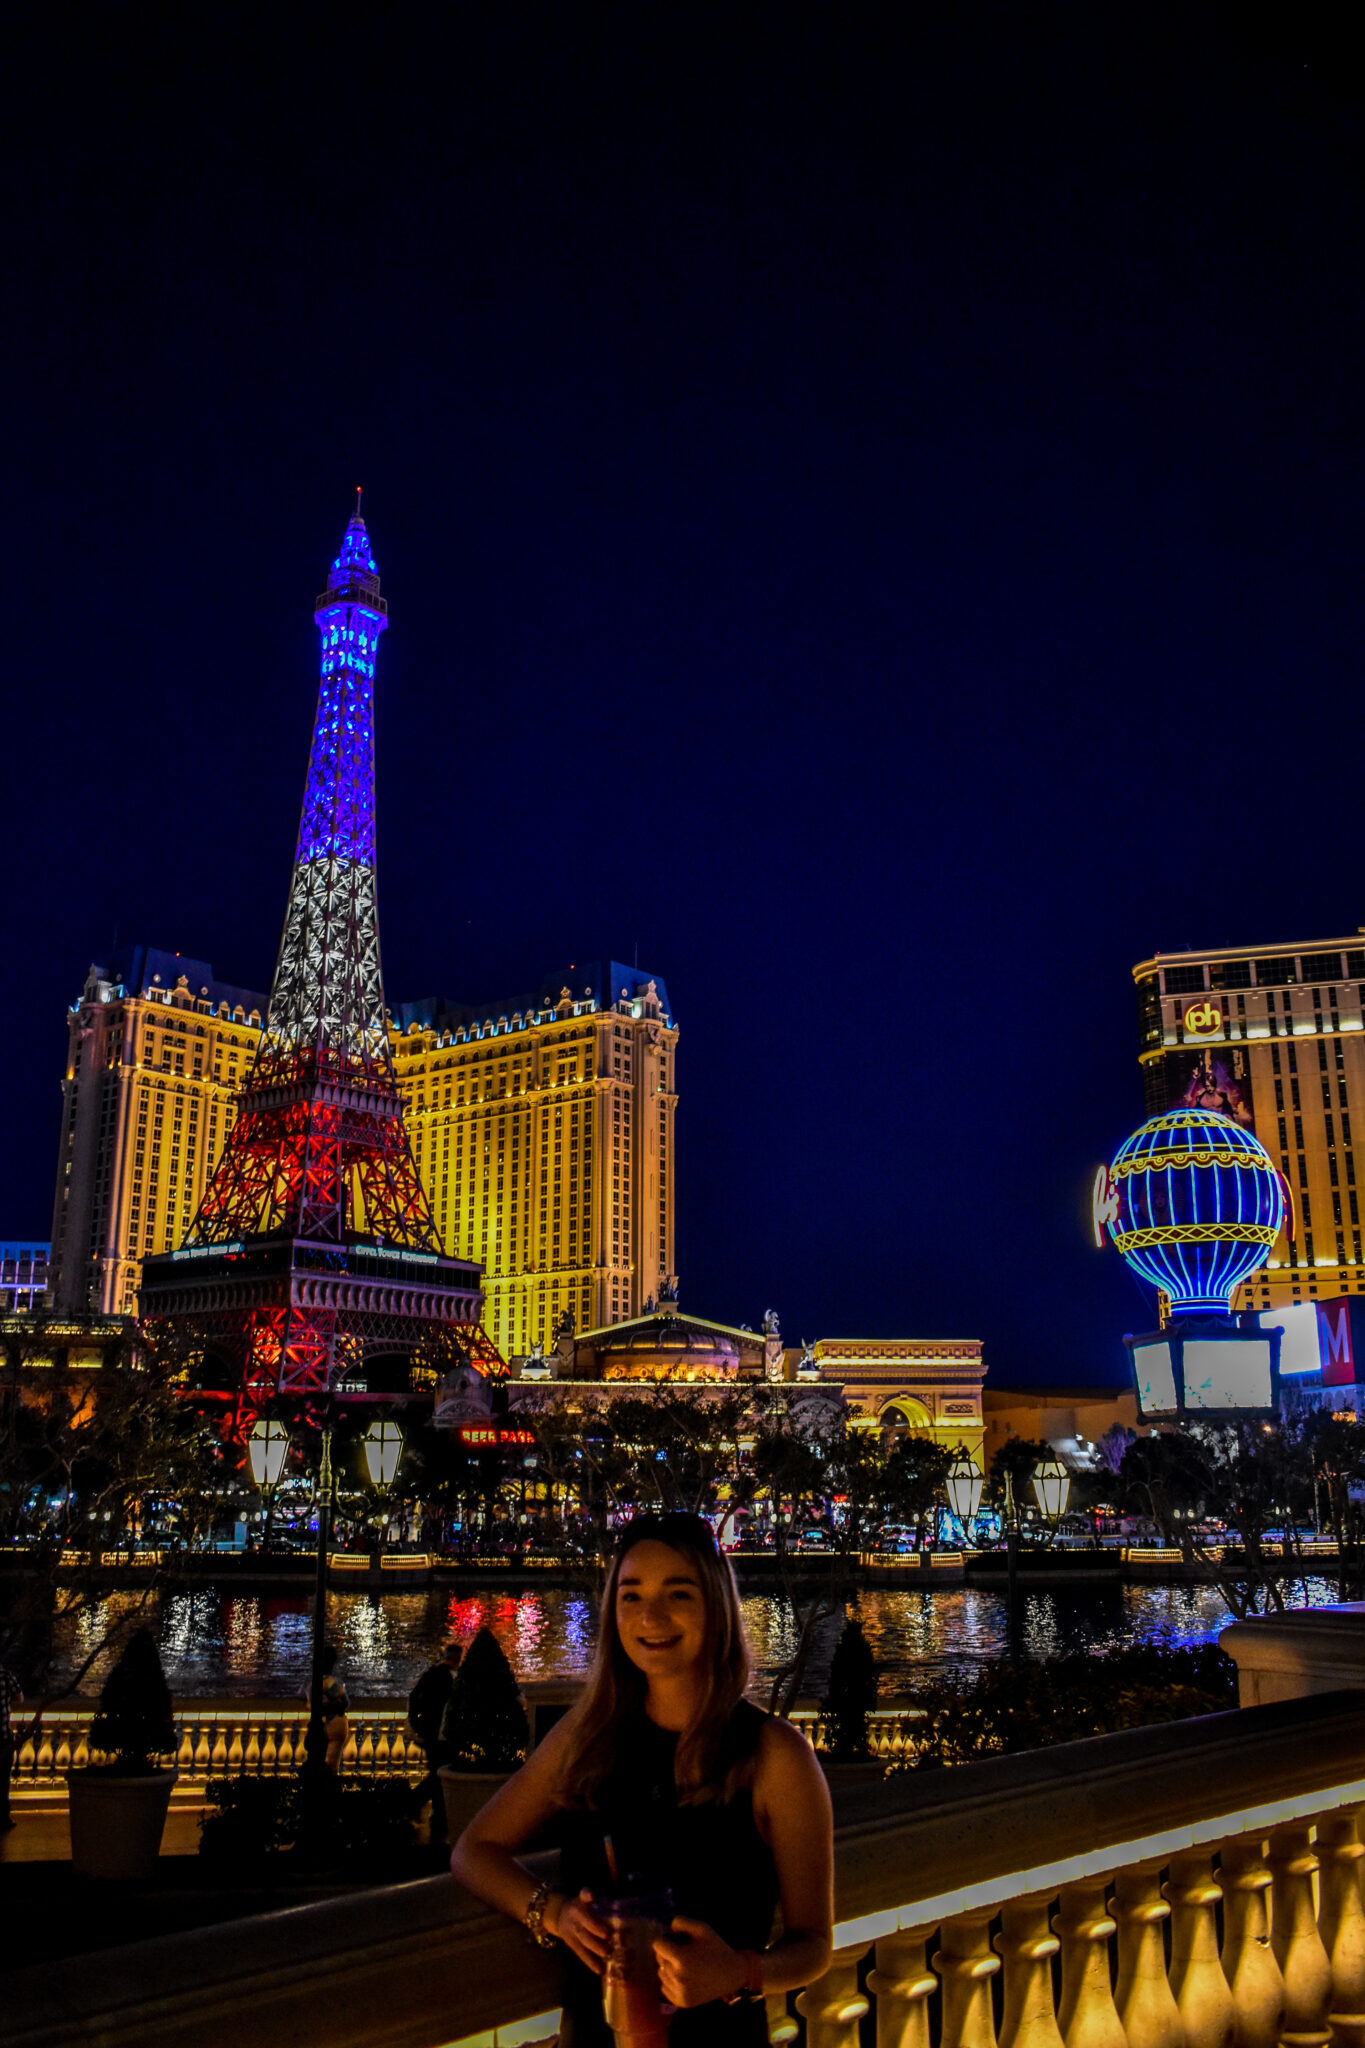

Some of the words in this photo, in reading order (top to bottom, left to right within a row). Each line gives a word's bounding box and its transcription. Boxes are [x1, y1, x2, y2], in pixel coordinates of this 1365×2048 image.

[1189, 1002, 1221, 1031] ph
[462, 1429, 497, 1443] BEER
[500, 1430, 536, 1444] PARK
